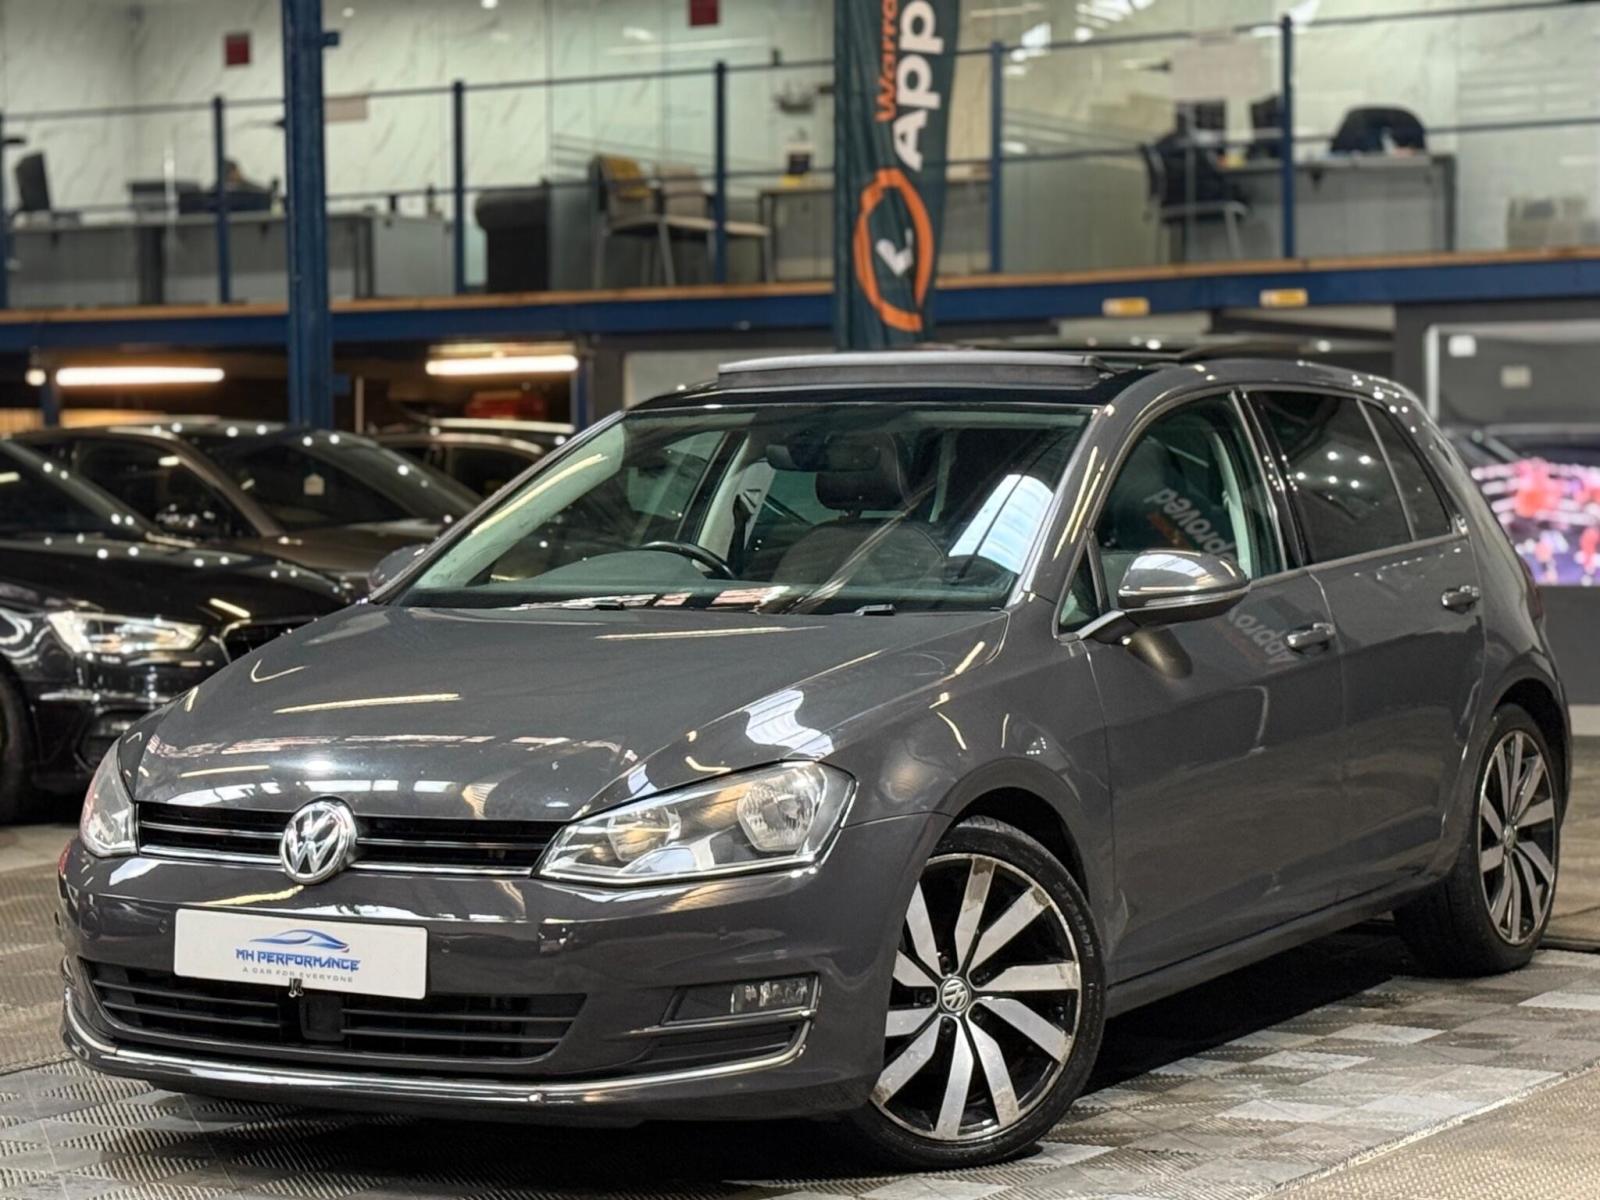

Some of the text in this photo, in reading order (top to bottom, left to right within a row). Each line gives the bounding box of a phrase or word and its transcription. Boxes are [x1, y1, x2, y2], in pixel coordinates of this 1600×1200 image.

[893, 0, 944, 172] App
[235, 948, 361, 973] MH PERFORMANCE
[252, 967, 273, 975] CAR
[276, 969, 296, 977] FOR
[299, 972, 354, 983] EVERYONE
